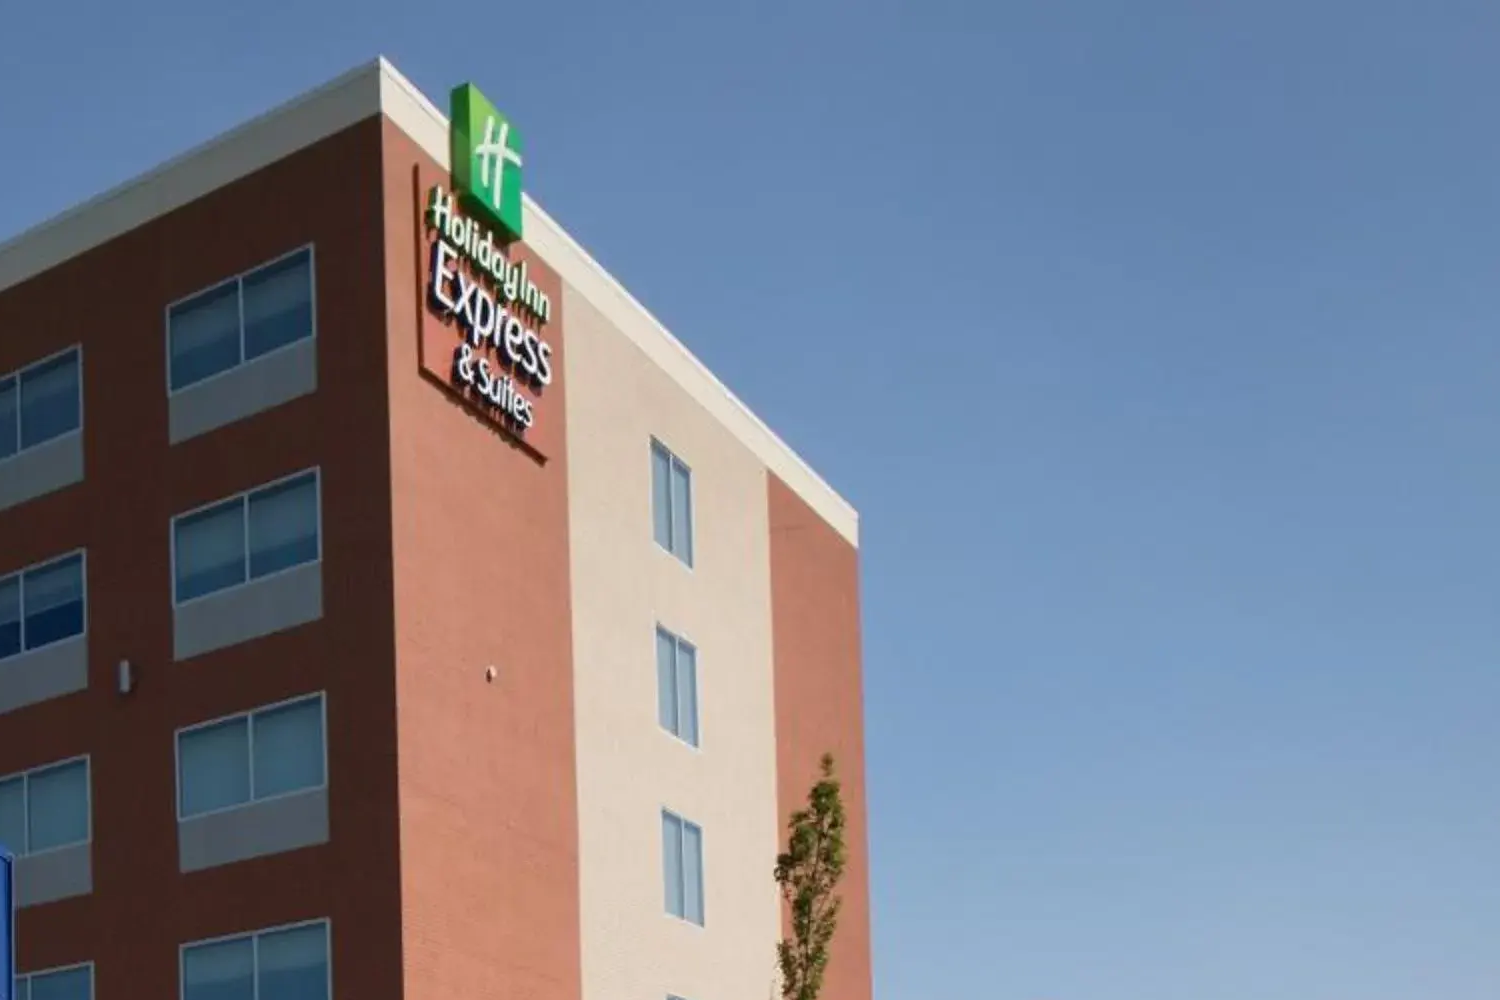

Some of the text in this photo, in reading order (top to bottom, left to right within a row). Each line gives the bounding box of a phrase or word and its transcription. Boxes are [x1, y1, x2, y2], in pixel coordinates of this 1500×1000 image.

[432, 185, 551, 322] Holiday Inn
[433, 239, 553, 386] Express
[457, 343, 534, 428] & Suites
